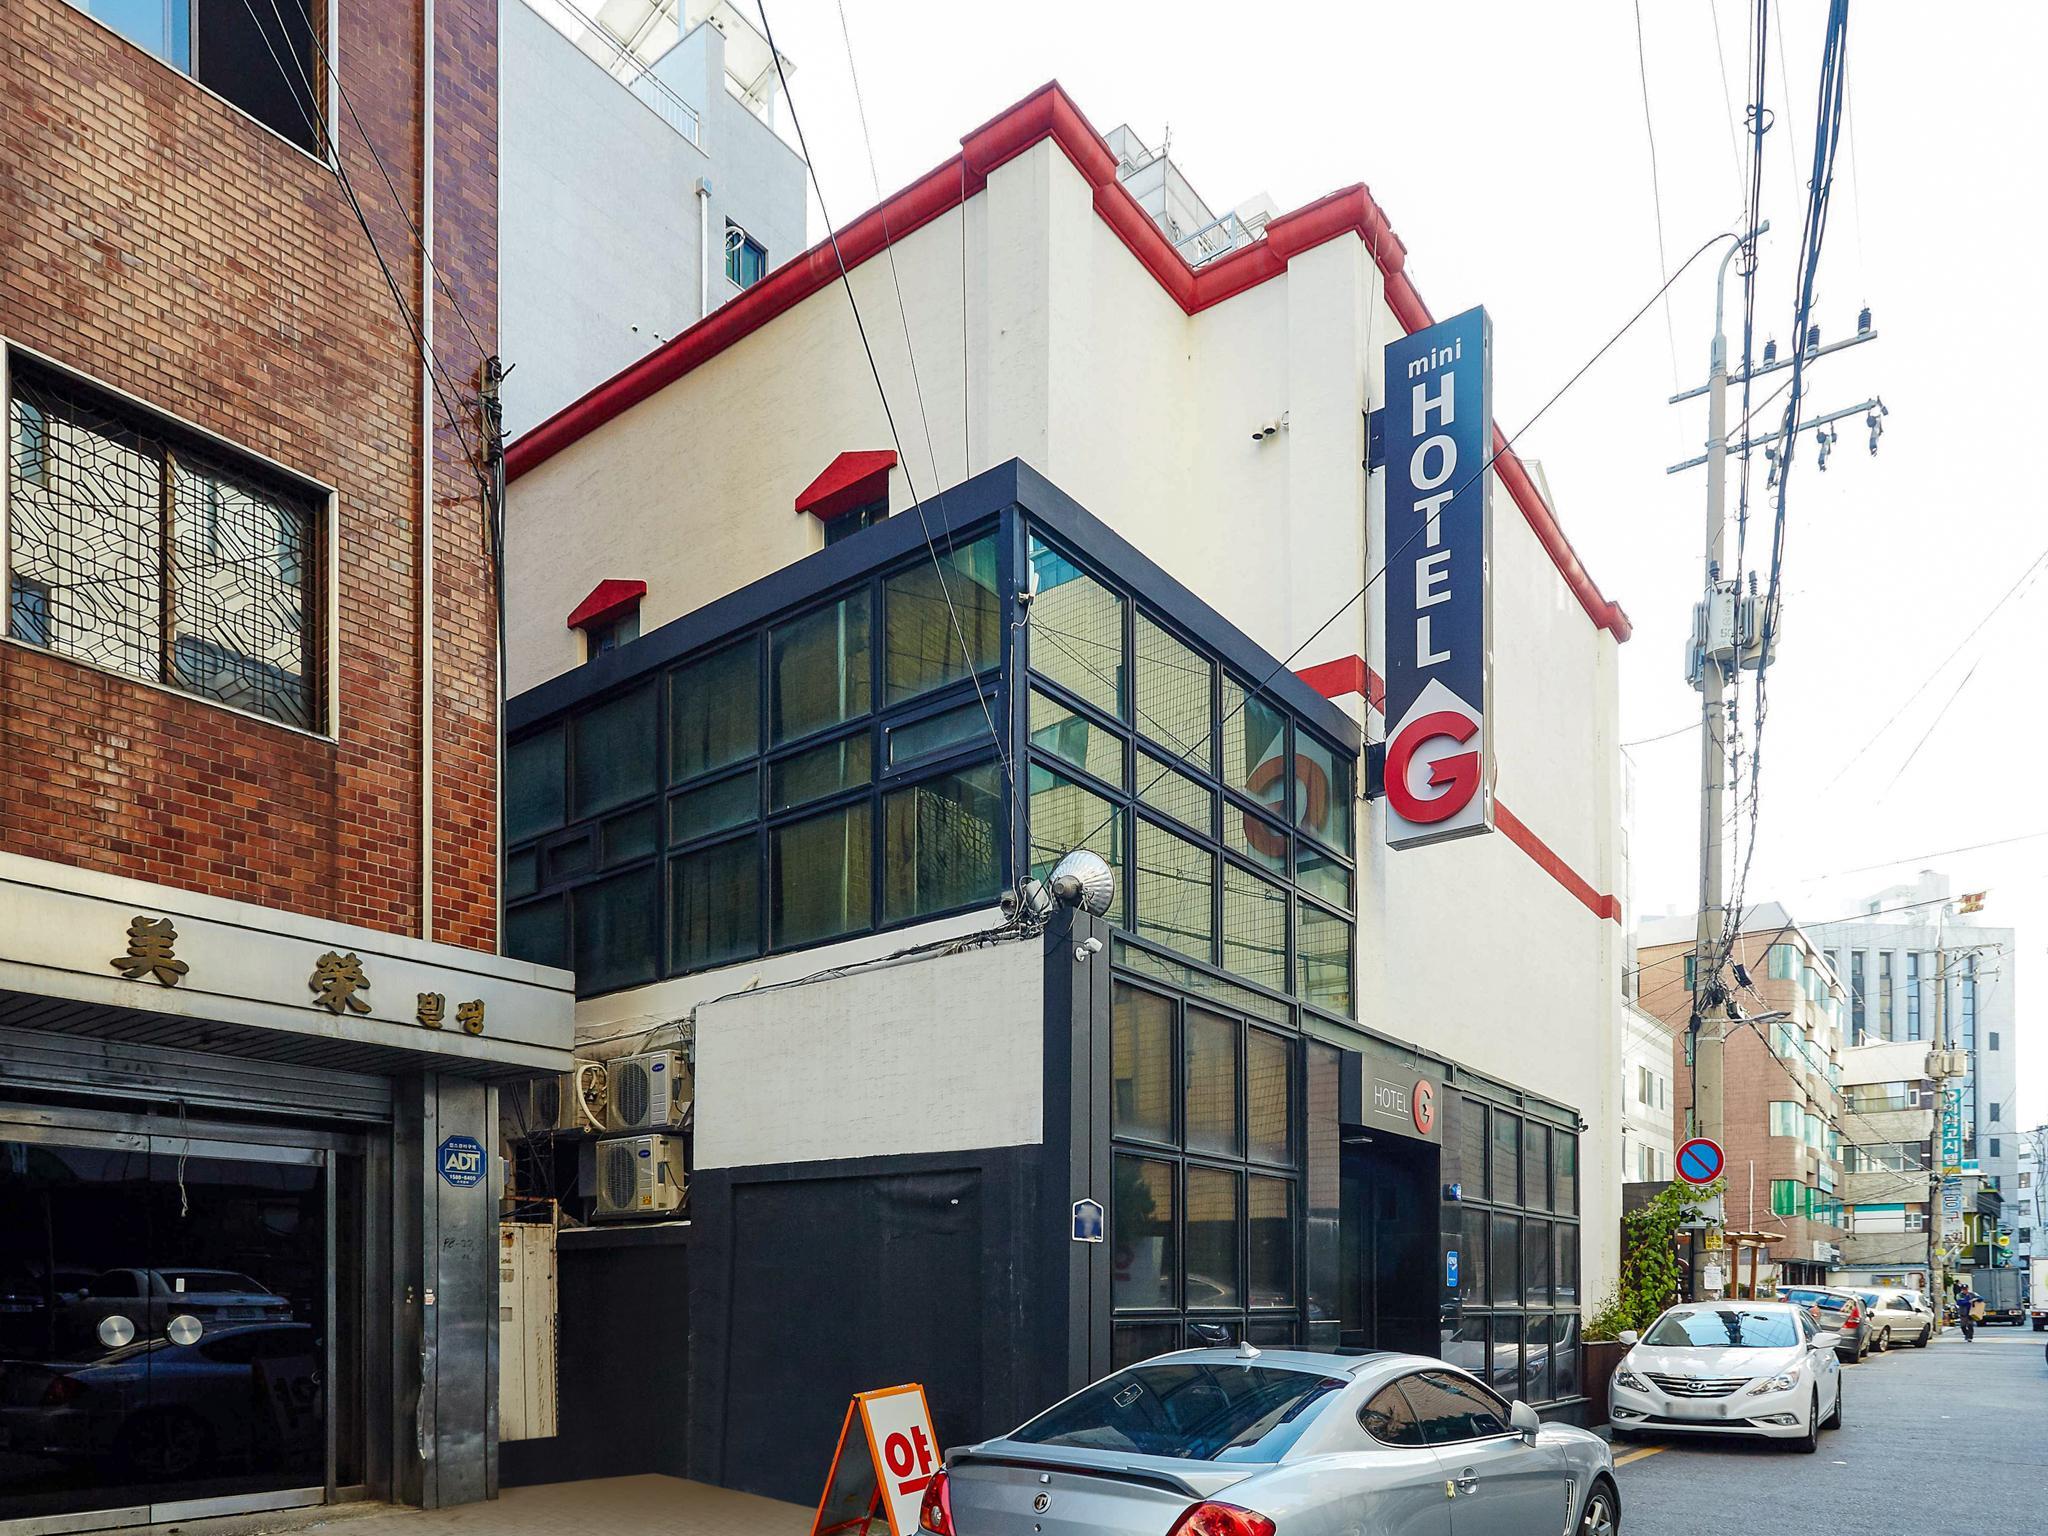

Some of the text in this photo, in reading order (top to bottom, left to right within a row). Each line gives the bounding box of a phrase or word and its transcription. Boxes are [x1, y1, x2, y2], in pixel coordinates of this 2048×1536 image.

[1408, 337, 1462, 379] mini
[1411, 371, 1458, 669] HOTEL
[1384, 709, 1482, 824] G
[1374, 1079, 1434, 1135] HOTEL G
[445, 1152, 480, 1171] ADT
